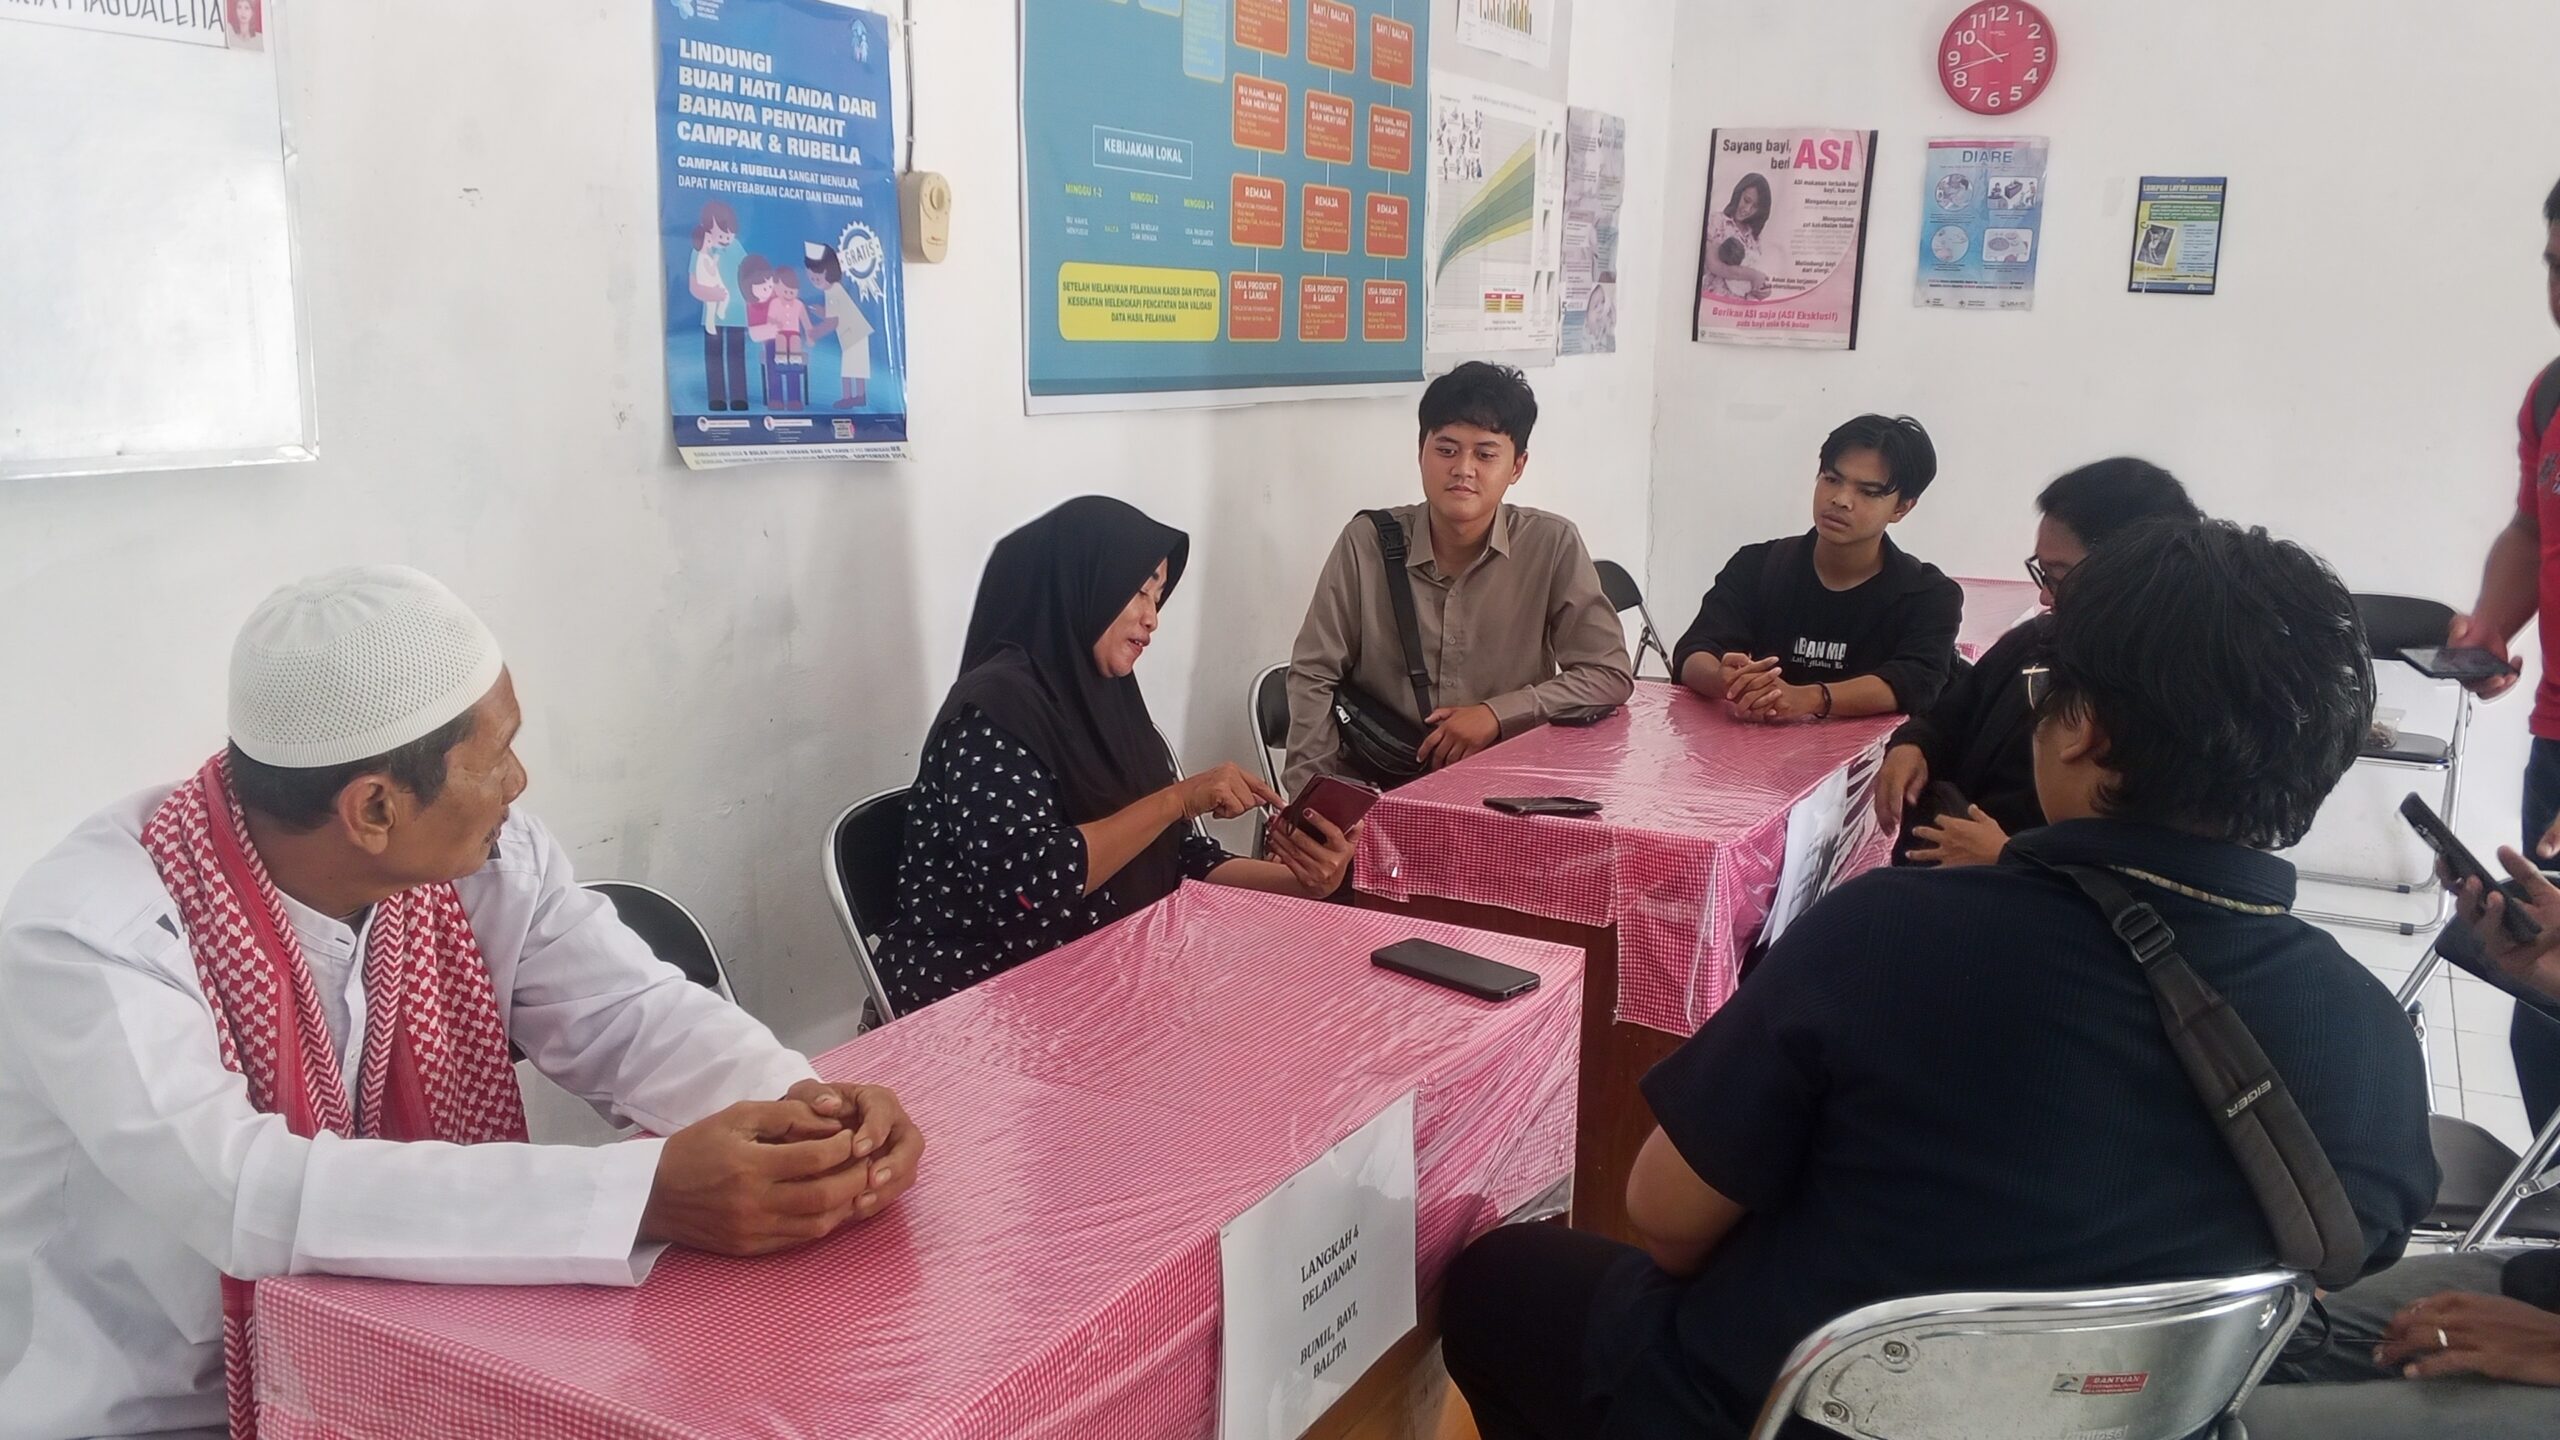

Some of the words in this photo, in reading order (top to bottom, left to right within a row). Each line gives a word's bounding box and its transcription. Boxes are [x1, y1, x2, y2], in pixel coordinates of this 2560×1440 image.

[1989, 5, 2009, 21] 12
[2016, 10, 2024, 26] 1
[1970, 14, 1986, 29] 11
[1955, 30, 1975, 45] 10
[2027, 23, 2041, 39] 2
[679, 38, 772, 73] LINDUNGI
[1948, 51, 1960, 66] 9
[2033, 47, 2046, 63] 3
[1953, 71, 1967, 88] 8
[2023, 68, 2039, 84] 4
[679, 66, 733, 93] BUAH
[740, 77, 780, 101] HATI
[786, 85, 834, 111] ANDA
[839, 94, 876, 119] DARI
[1970, 87, 1981, 102] 7
[1987, 92, 2000, 107] 6
[2009, 86, 2022, 101] 5
[678, 93, 756, 124] BAHAYA
[762, 107, 845, 138] PENYAKIT
[677, 121, 763, 150] CAMPAK
[768, 134, 781, 154] &
[787, 137, 861, 166] RUBELLA
[1104, 137, 1154, 159] KEBIJAKAN
[1156, 146, 1183, 163] LOKAL
[1723, 139, 1762, 154] Sayang
[1766, 139, 1791, 154] bayi,
[1793, 139, 1853, 170] ASI
[1962, 150, 2013, 163] DIARE
[1771, 157, 1790, 169] beri
[678, 156, 729, 172] CAMPAK
[731, 164, 738, 173] &
[740, 164, 787, 181] RUBELLA
[788, 171, 819, 184] SANGAT
[820, 174, 860, 190] MENULAR,
[678, 175, 708, 188] DAPAT
[710, 179, 777, 196] MENYEBABKAN
[779, 187, 804, 200] CACAT
[806, 190, 821, 202] DAN
[823, 191, 862, 208] KEMATIAN
[1245, 186, 1272, 200] REMAJA
[1315, 195, 1339, 208] REMAJA
[1063, 281, 1091, 292] SETELAH
[1092, 283, 1128, 294] MELAKUKAN
[1129, 285, 1162, 295] PELAYANAN
[1163, 286, 1180, 296] KADER
[1181, 287, 1192, 296] DAN
[1193, 288, 1216, 297] PETUGAS
[1067, 296, 1103, 307] KESEHATAN
[1143, 299, 1177, 309] PENCATATAN
[1178, 300, 1189, 309] DAN
[1112, 312, 1126, 322] DATA
[1127, 313, 1144, 323] HASIL
[1145, 313, 1176, 323] PELAYANAN
[1713, 307, 1743, 317] Berikan
[1745, 309, 1757, 318] ASI
[1759, 310, 1776, 319] saja
[1778, 310, 1795, 320] (ASI
[1797, 311, 1838, 322] Eksklusif)
[2227, 1080, 2272, 1118] EIGER
[1301, 1229, 1352, 1284] LANGKAH
[1353, 1224, 1359, 1238] 4
[1302, 1250, 1357, 1312] PELAYANAN
[1300, 1326, 1335, 1366] BUMIL,
[1337, 1300, 1358, 1332] BAYI,
[1313, 1337, 1347, 1379] BALITA
